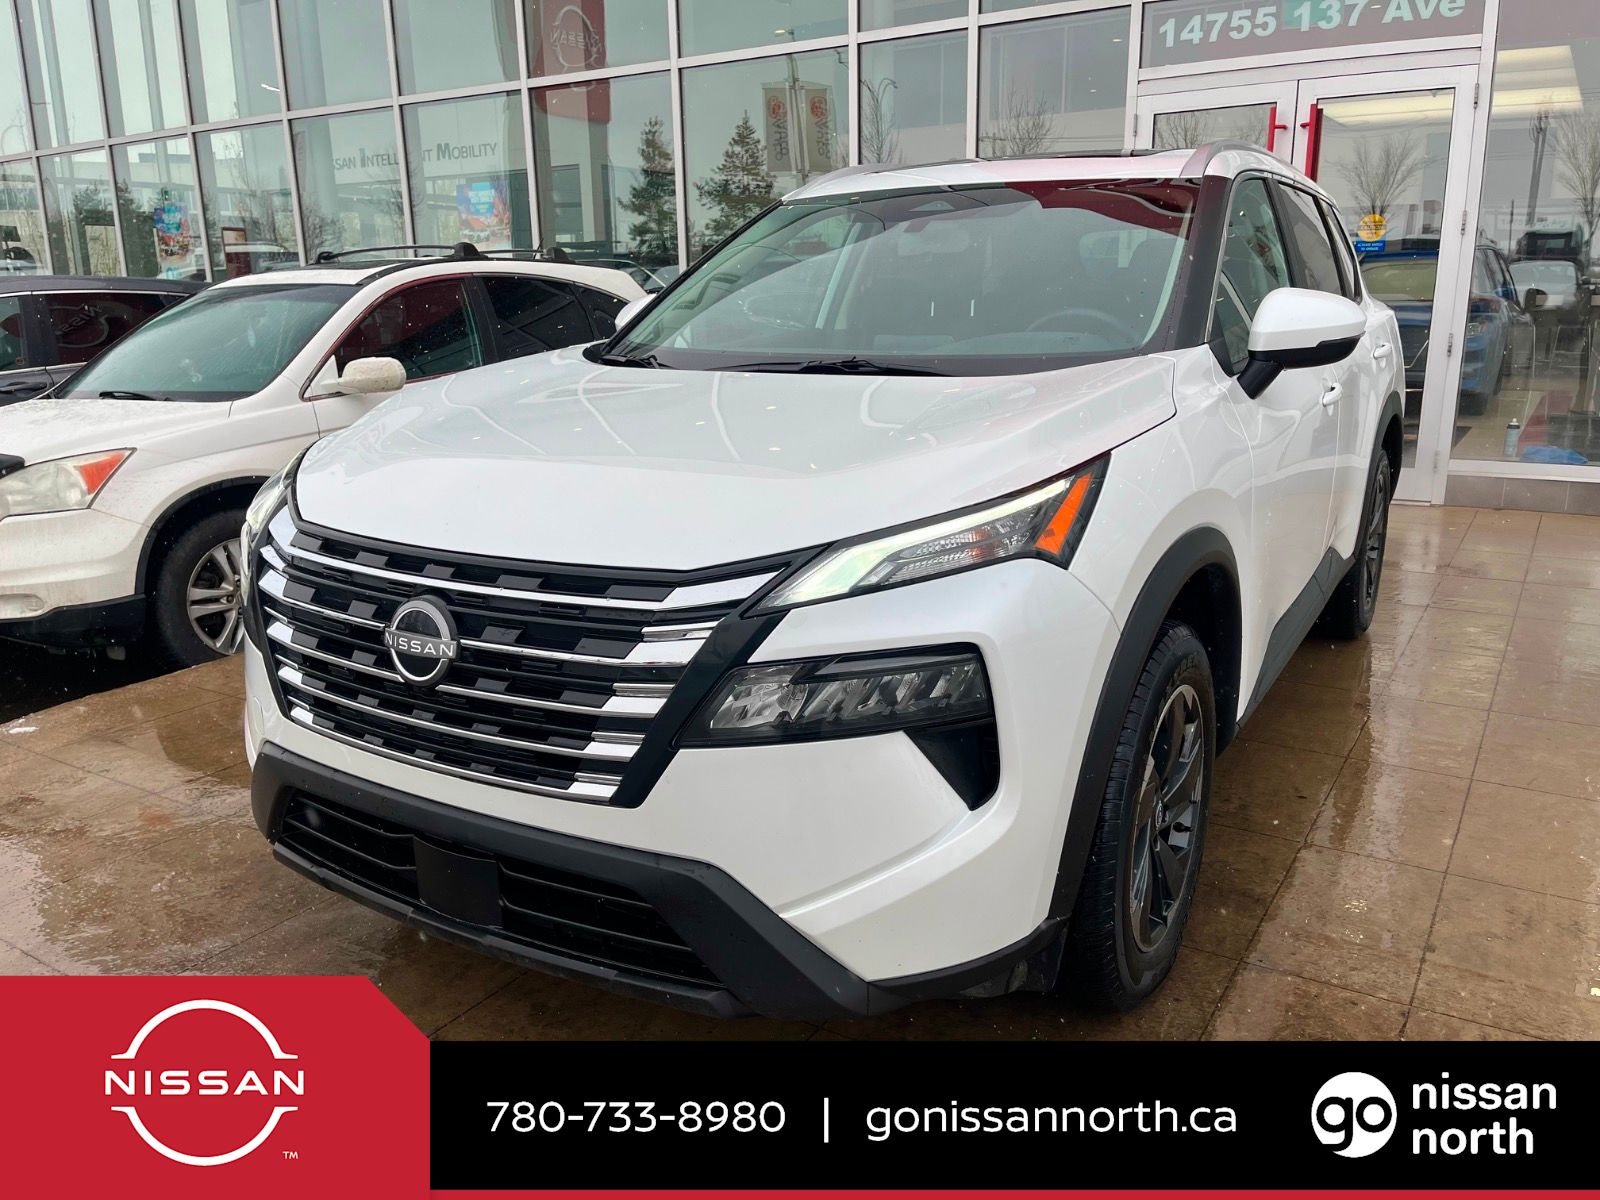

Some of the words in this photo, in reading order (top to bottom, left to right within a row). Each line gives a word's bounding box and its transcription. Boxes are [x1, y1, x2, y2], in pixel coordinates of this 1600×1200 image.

[1159, 6, 1277, 48] 14755
[1293, 0, 1366, 32] 137
[1381, 0, 1466, 24] Ave
[436, 142, 497, 161] MOBILITY
[385, 632, 454, 657] NISSAN
